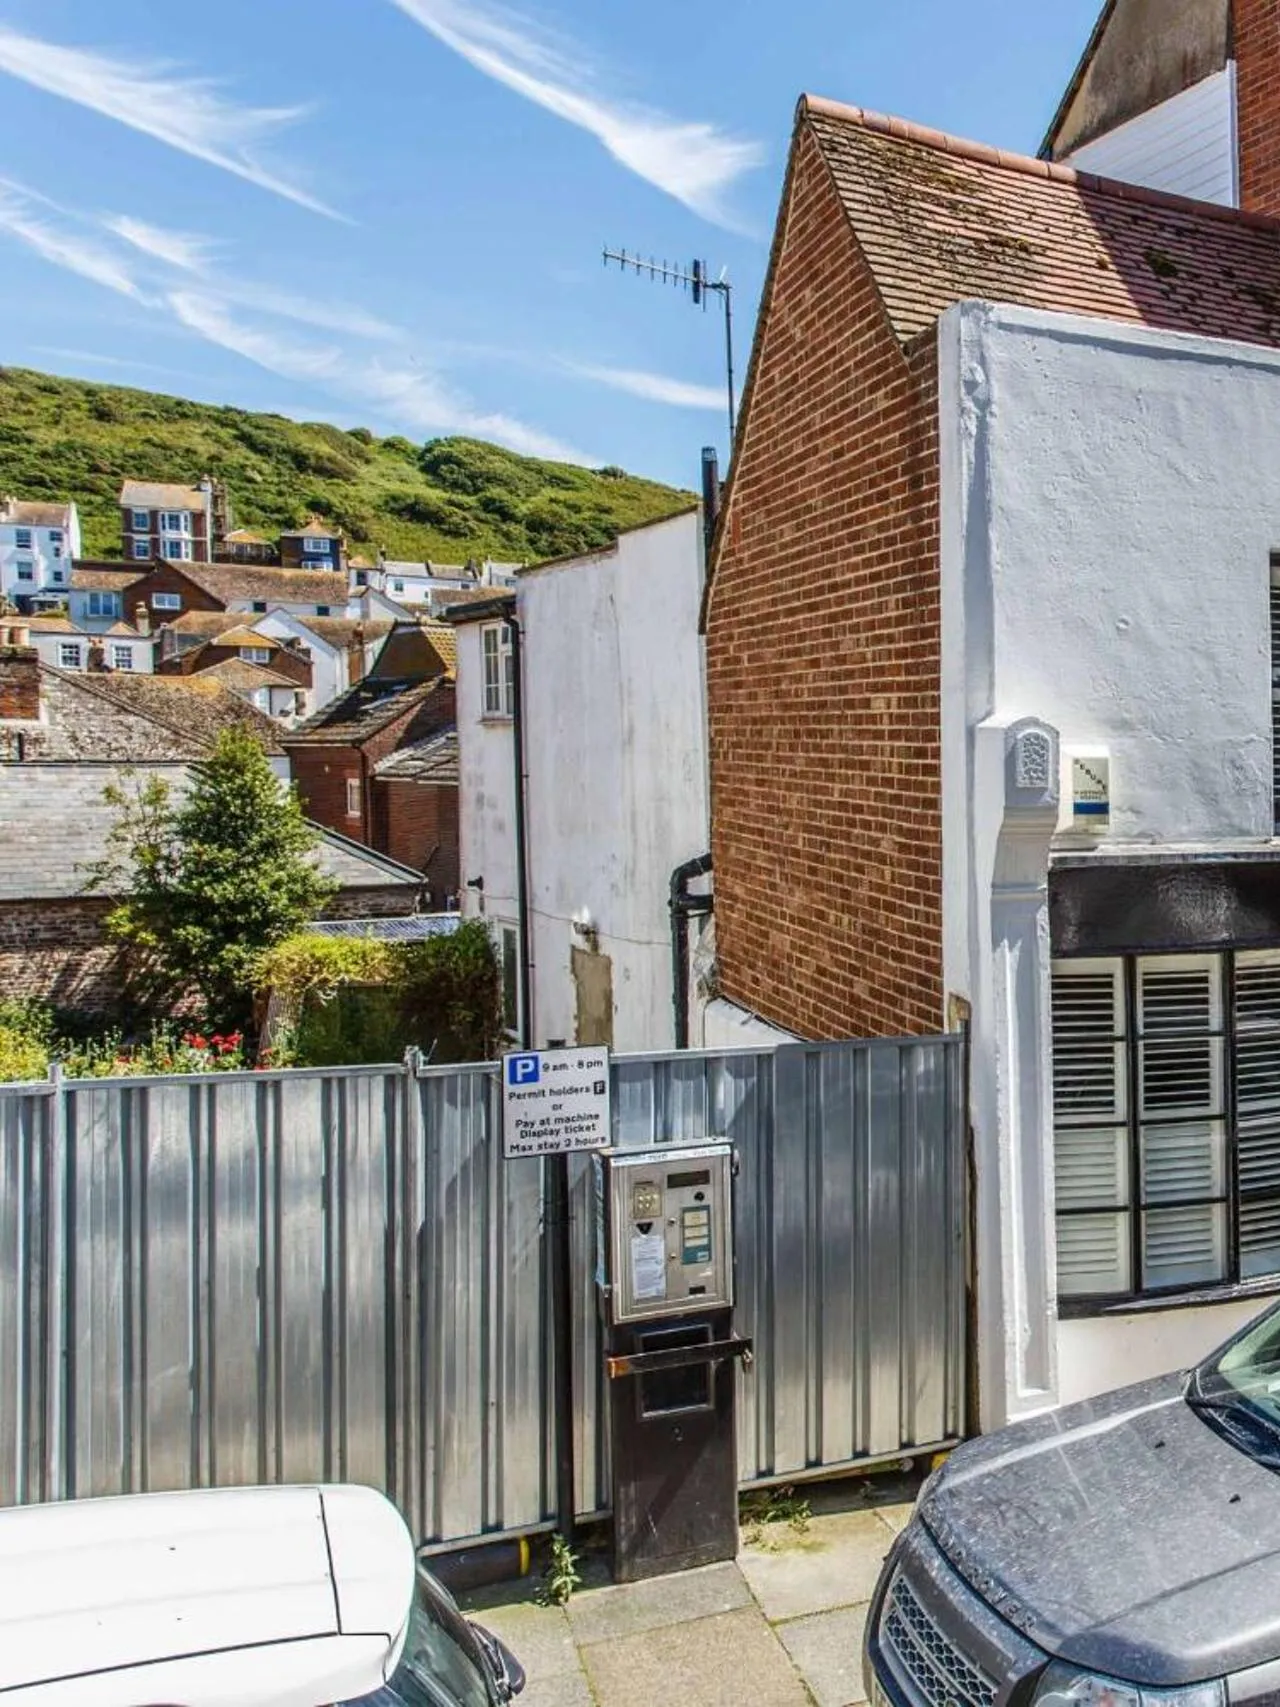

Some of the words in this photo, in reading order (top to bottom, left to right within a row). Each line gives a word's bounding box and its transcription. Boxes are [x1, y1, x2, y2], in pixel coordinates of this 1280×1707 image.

[516, 1060, 535, 1082] P
[508, 1089, 546, 1101] Permit
[549, 1086, 591, 1097] holders
[552, 1103, 563, 1111] or
[515, 1119, 535, 1129] Pay
[540, 1117, 551, 1126] at
[554, 1113, 600, 1124] machine
[520, 1127, 560, 1139] Display
[564, 1124, 596, 1134] ticket
[510, 1143, 533, 1153] Max
[537, 1141, 560, 1152] stay
[564, 1138, 572, 1148] 2
[575, 1136, 607, 1146] hours
